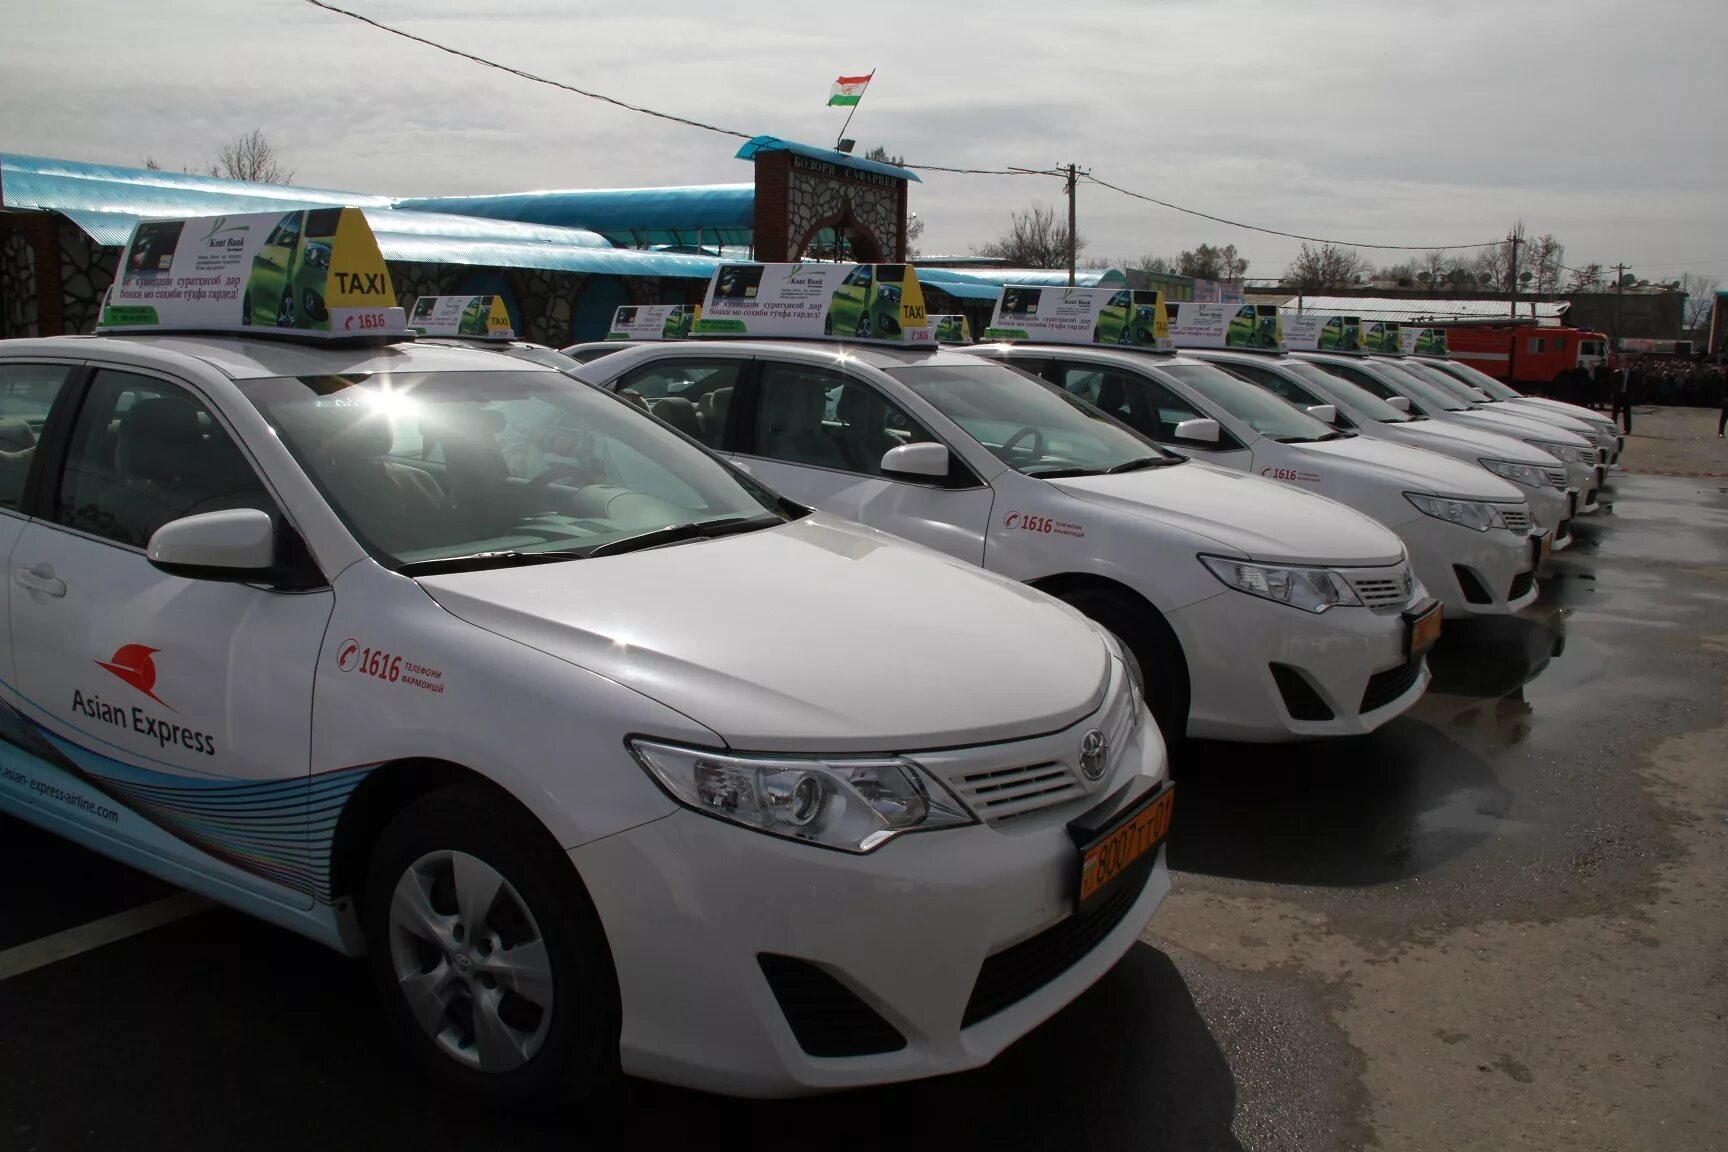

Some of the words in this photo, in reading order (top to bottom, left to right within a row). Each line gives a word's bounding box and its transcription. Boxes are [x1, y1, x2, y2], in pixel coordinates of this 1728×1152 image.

[227, 237, 244, 247] Bank
[334, 272, 386, 295] TAXI
[144, 291, 154, 299] мо
[903, 305, 923, 319] TAXI
[358, 314, 385, 328] 1616
[491, 317, 508, 326] TAXI
[1273, 469, 1297, 481] 1616
[1021, 515, 1053, 533] 1616
[359, 647, 402, 683] 1616
[405, 662, 442, 680] ТЕЛЕФОНИ
[72, 689, 127, 728] Asian
[131, 706, 216, 756] Express
